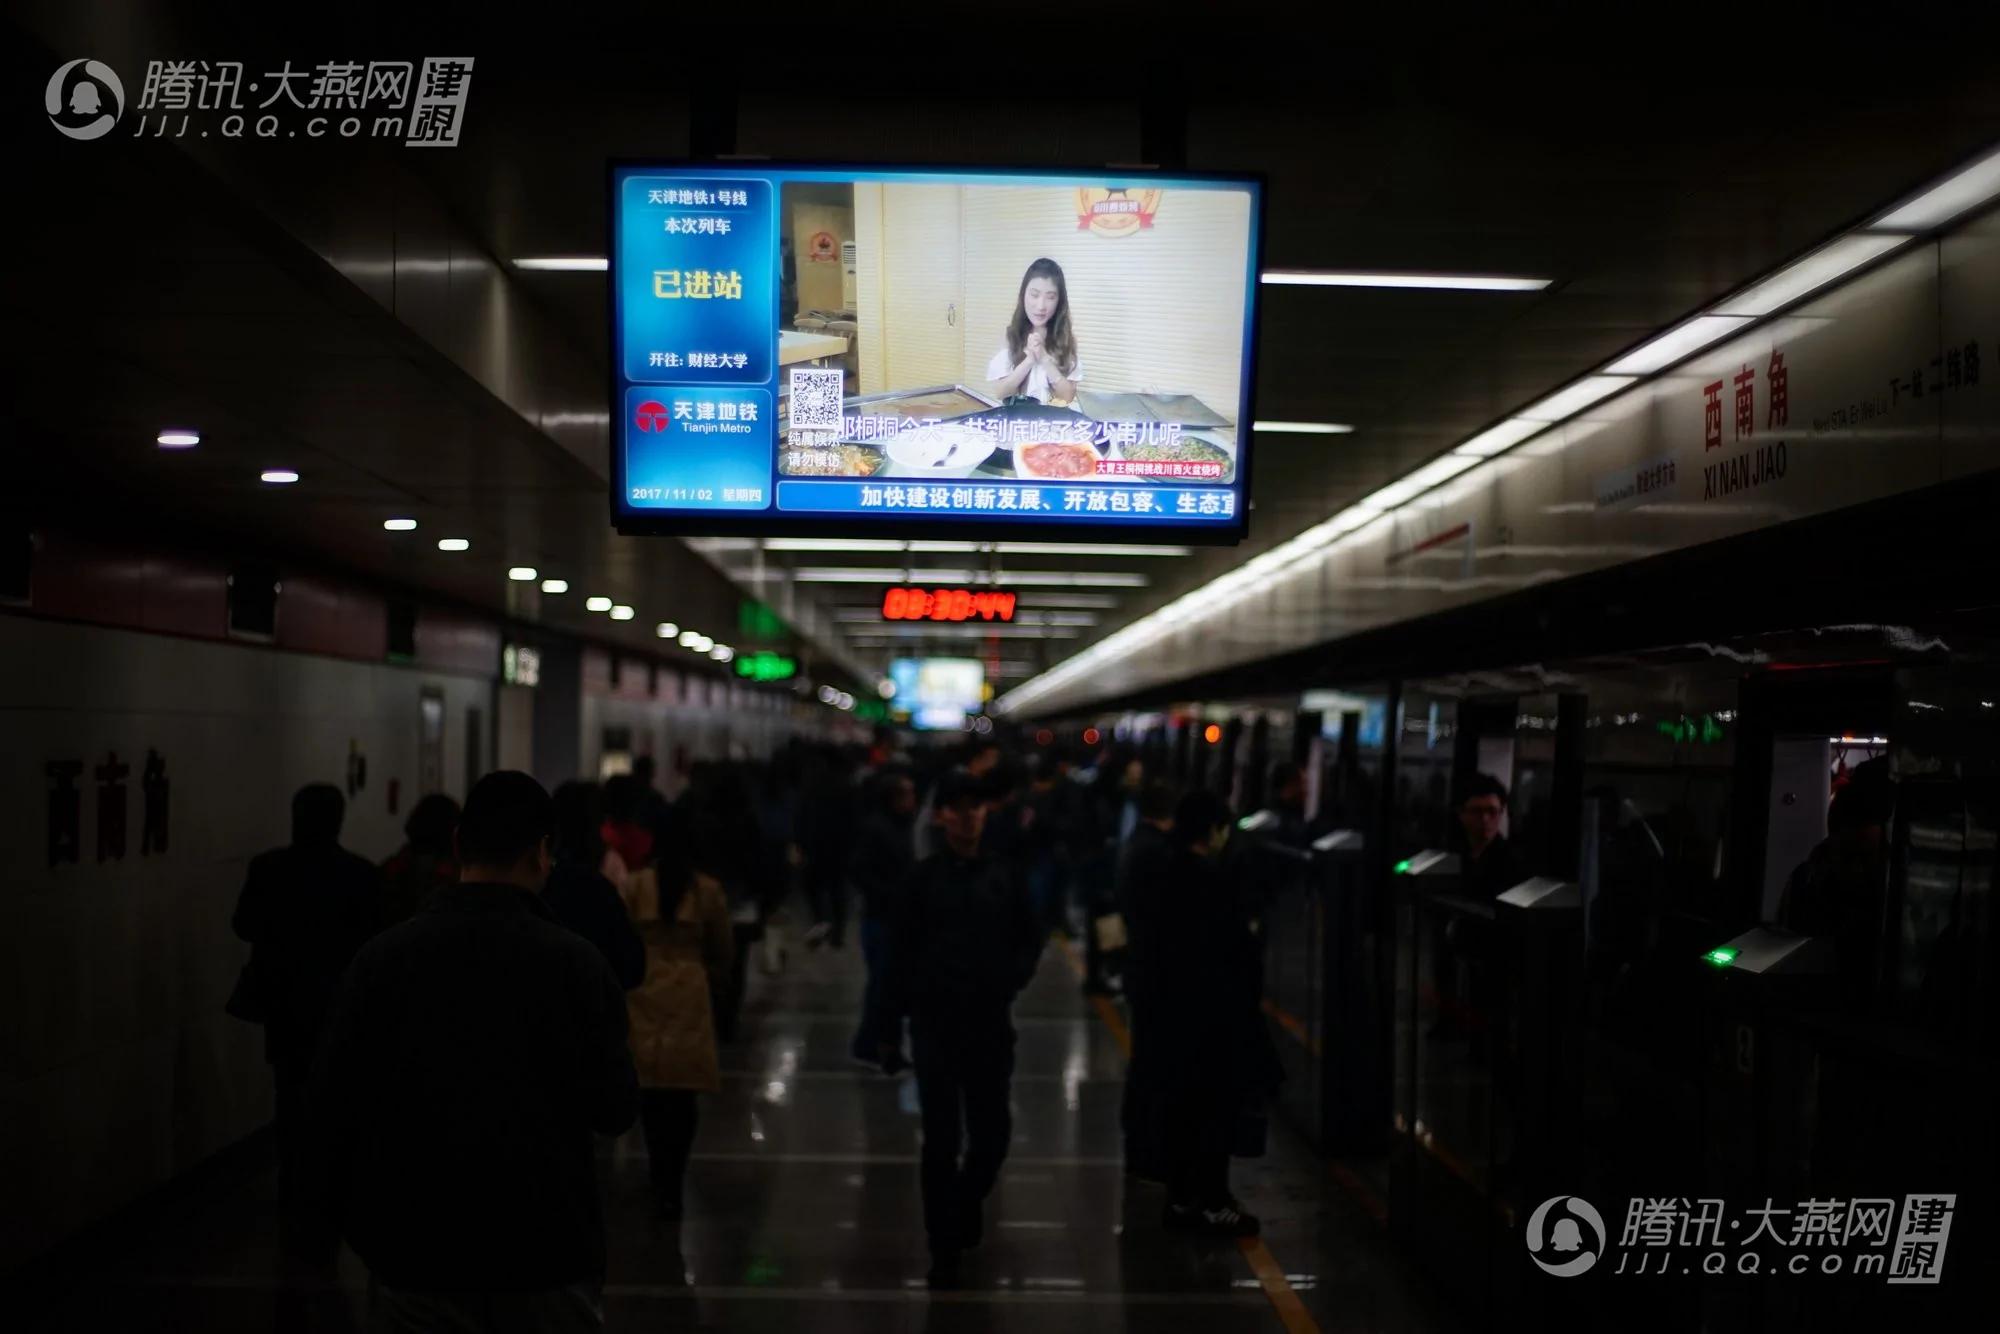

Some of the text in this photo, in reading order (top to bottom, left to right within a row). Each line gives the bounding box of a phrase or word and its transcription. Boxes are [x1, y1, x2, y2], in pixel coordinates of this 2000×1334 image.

[648, 189, 748, 206] 天津地铁1号线
[664, 218, 731, 235] 本次列车
[653, 271, 742, 300] 已进站
[1703, 348, 1788, 452] 西南角
[674, 401, 758, 421] 天津地铁
[682, 423, 752, 435] Tianjin Metro
[788, 451, 840, 467] 请勿模仿
[723, 488, 762, 502] 星期四
